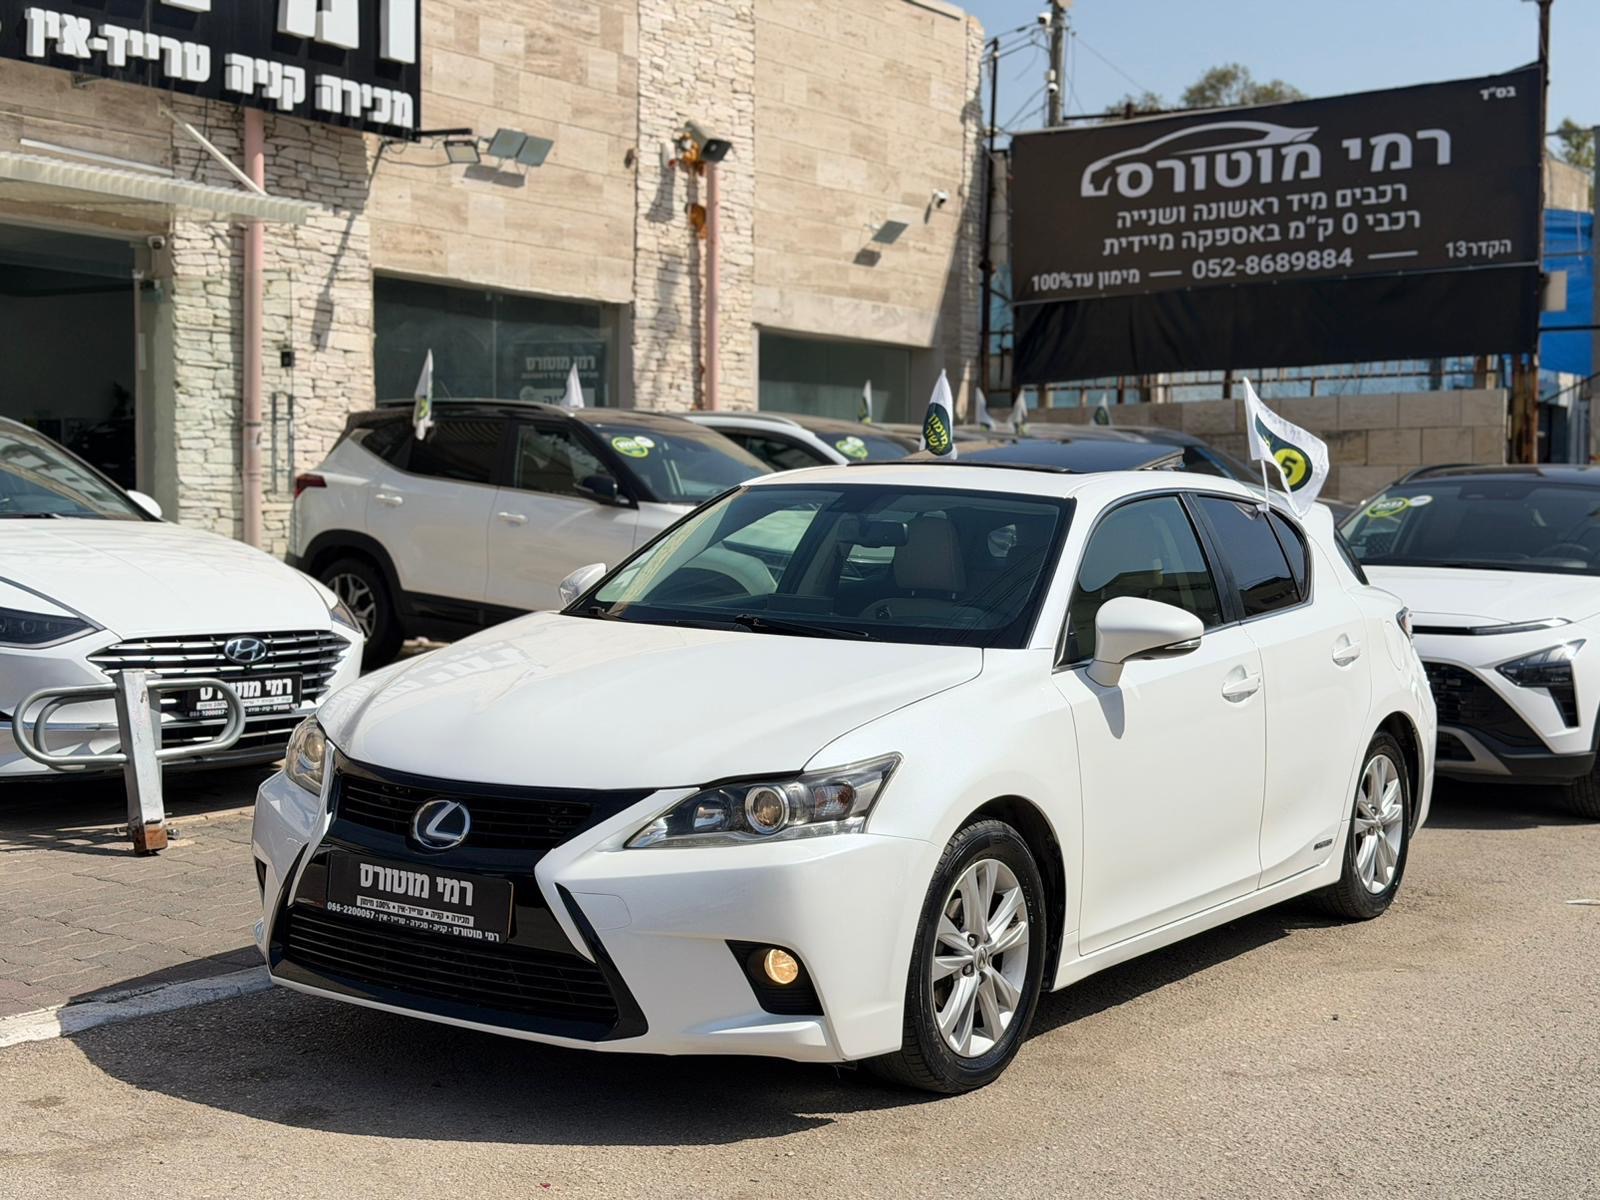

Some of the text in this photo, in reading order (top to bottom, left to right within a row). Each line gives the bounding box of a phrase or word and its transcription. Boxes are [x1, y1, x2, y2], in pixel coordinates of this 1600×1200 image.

[25, 7, 211, 82] טרייד-אין
[225, 53, 306, 111] קניה
[315, 74, 414, 128] מכירה
[1116, 128, 1451, 198] רמי מוטורס
[1117, 183, 1408, 229] רכבים מיד ראשונה ושנייה
[1342, 212, 1358, 234] 0
[1365, 210, 1421, 232] רכבי
[1102, 233, 1174, 256] מיידית
[1181, 223, 1281, 252] באספקה
[1192, 248, 1353, 279] 052-8689884
[1098, 268, 1140, 289] מימון
[265, 678, 293, 696] רמי
[360, 863, 473, 906] רמי מוטורס
[327, 901, 375, 919] 055-2200057
[453, 926, 483, 939] מוטורס
[485, 931, 500, 942] רמי
